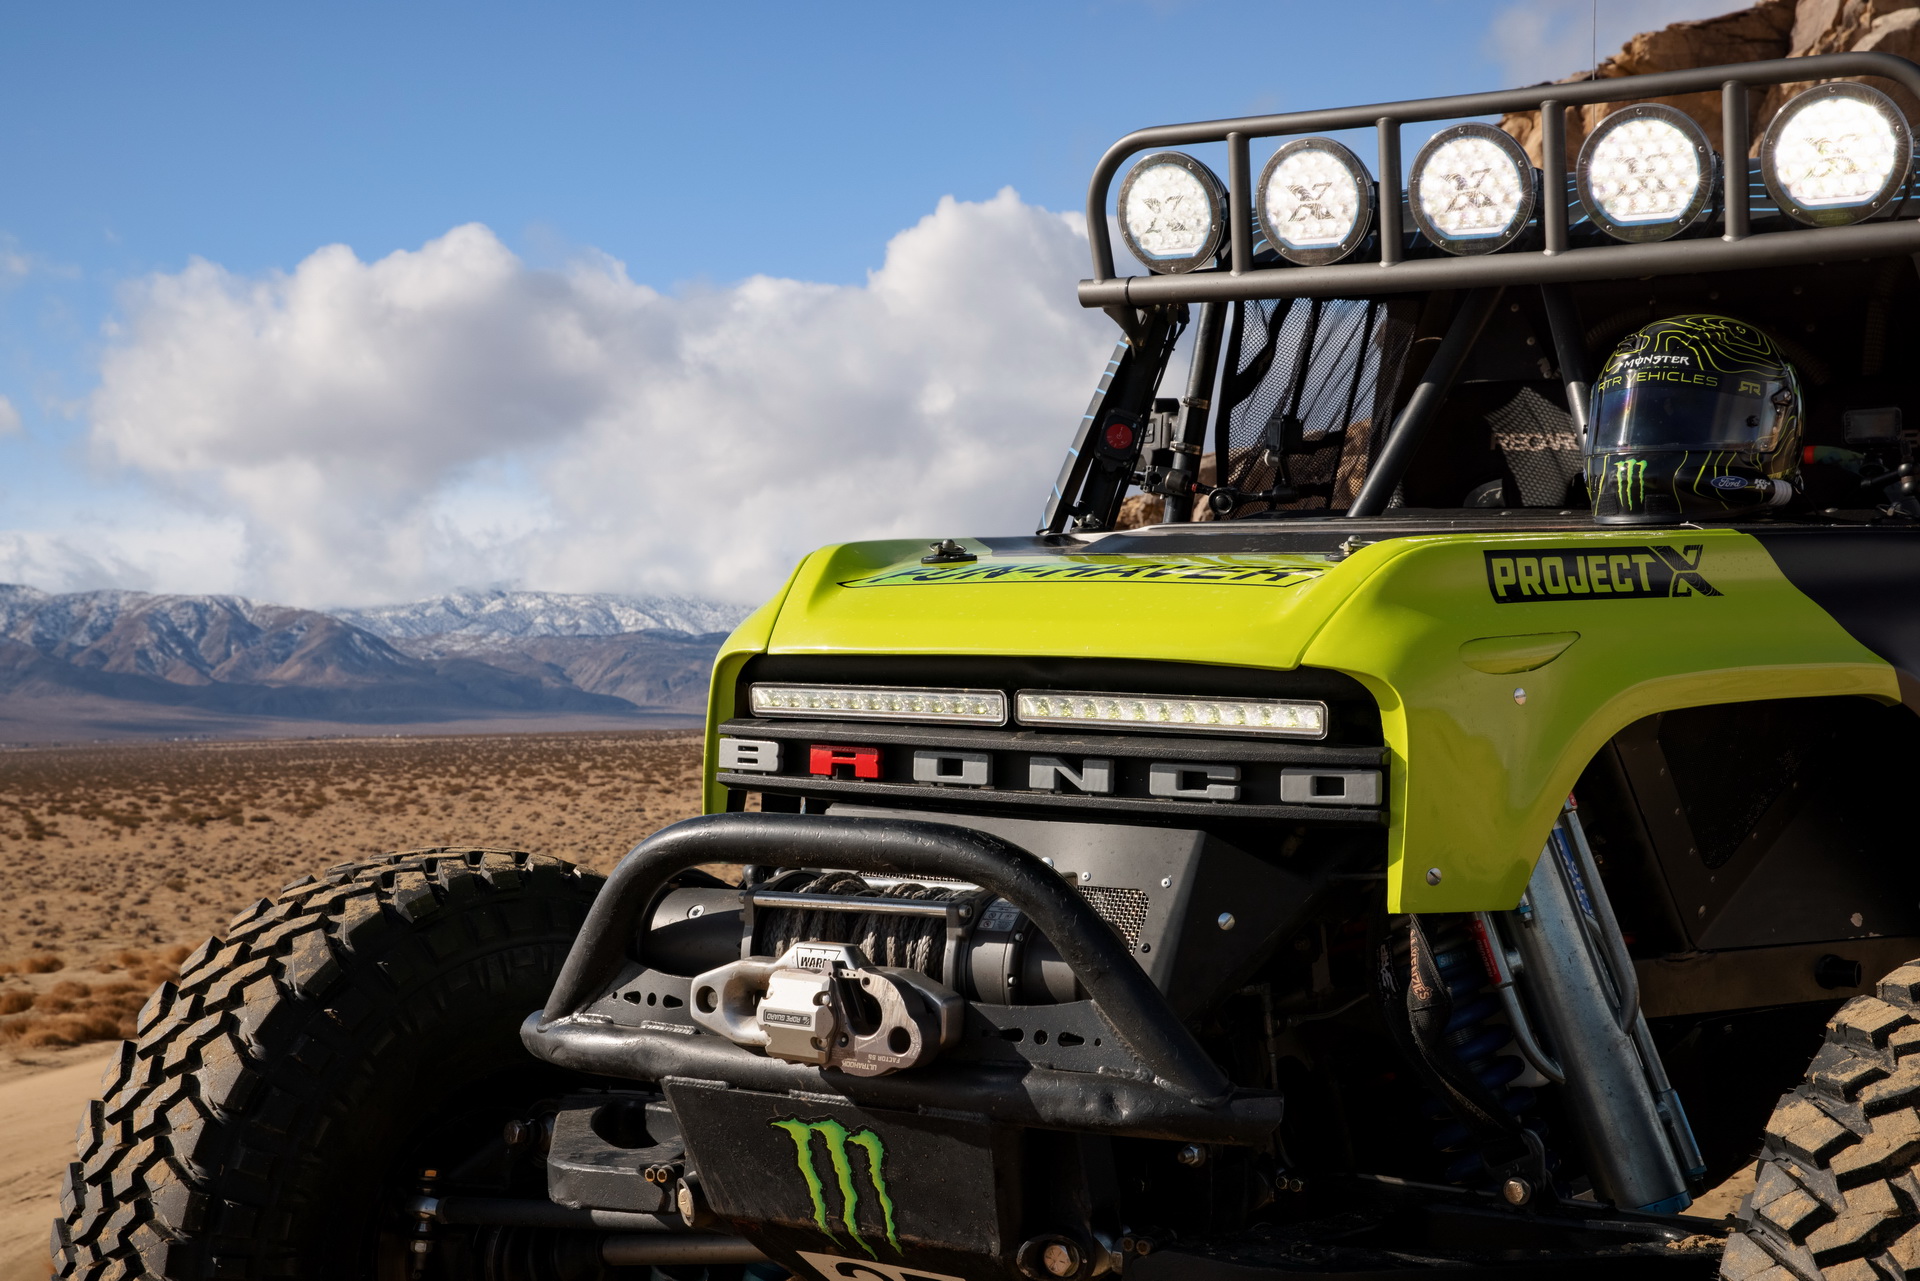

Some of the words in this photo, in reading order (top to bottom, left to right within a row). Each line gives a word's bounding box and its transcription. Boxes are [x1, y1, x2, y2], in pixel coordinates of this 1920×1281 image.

[1598, 375, 1622, 393] RTR
[1625, 371, 1718, 387] VEHICLES
[1489, 432, 1580, 451] RECAR
[866, 564, 1326, 583] FUN-HAVER
[1491, 554, 1657, 597] PROJECT
[718, 738, 1383, 805] BRONCO
[767, 1013, 785, 1022] GUARD
[786, 1015, 801, 1023] ROPE
[841, 1060, 878, 1071] ULTRAHOOK
[877, 1055, 901, 1064] FACTOR
